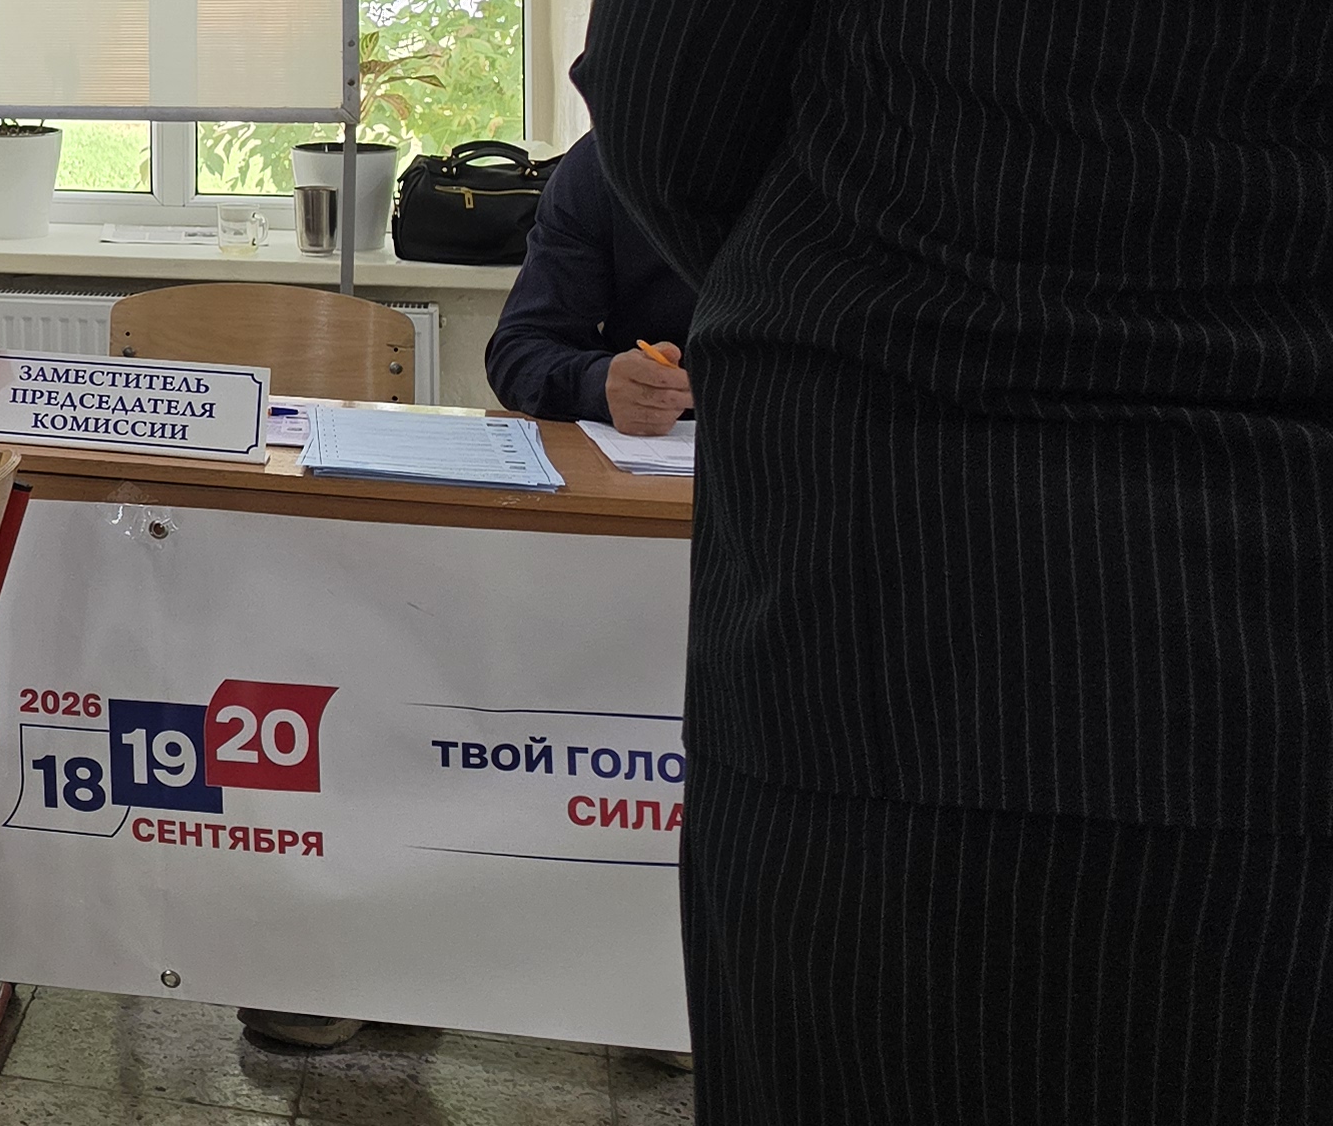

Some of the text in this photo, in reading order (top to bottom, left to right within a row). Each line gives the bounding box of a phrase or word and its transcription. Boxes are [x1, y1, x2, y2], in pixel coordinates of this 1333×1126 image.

[19, 365, 210, 394] ЗАМЕСТИТЕЛЬ
[9, 387, 216, 418] ПРЕДСЕДАТЕЛЯ
[32, 413, 189, 440] КОМИССИИ
[19, 688, 102, 718] 2026
[32, 706, 310, 813] 18 19 20
[432, 736, 686, 784] ТВОЙ ГОЛО
[132, 817, 325, 857] СЕНТЯБРЯ
